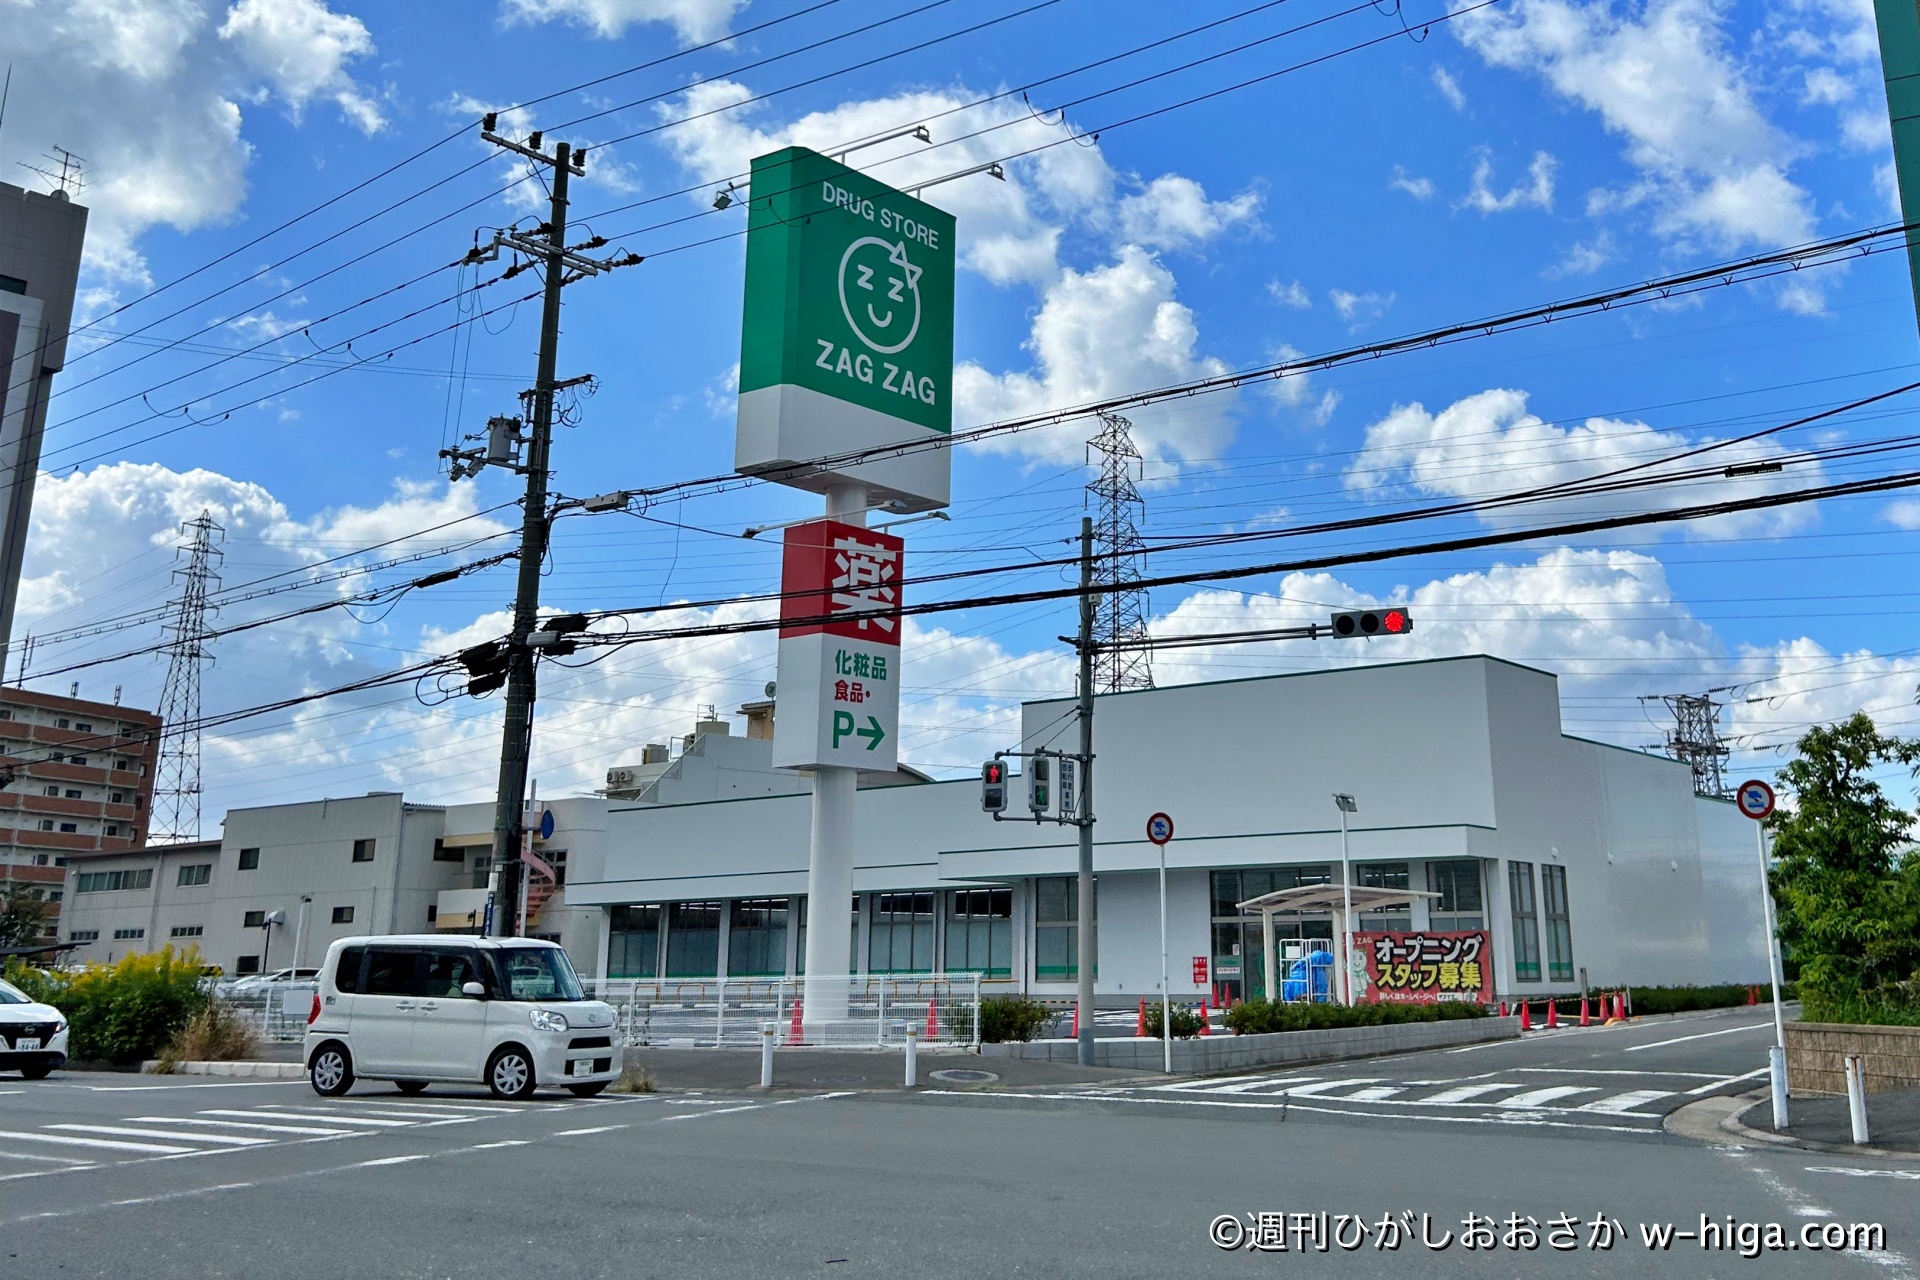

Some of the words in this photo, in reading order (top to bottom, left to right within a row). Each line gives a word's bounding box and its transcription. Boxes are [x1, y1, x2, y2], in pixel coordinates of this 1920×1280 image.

[823, 181, 874, 221] DRUG
[880, 208, 938, 250] STORE
[816, 339, 873, 384] ZAG
[882, 362, 935, 405] ZAG
[831, 536, 896, 633] 薬
[835, 649, 887, 681] 化粧品
[833, 710, 854, 749] P
[1357, 937, 1373, 945] ZAG
[1376, 935, 1483, 963] オープニング
[1377, 962, 1482, 989] スタッフ募集
